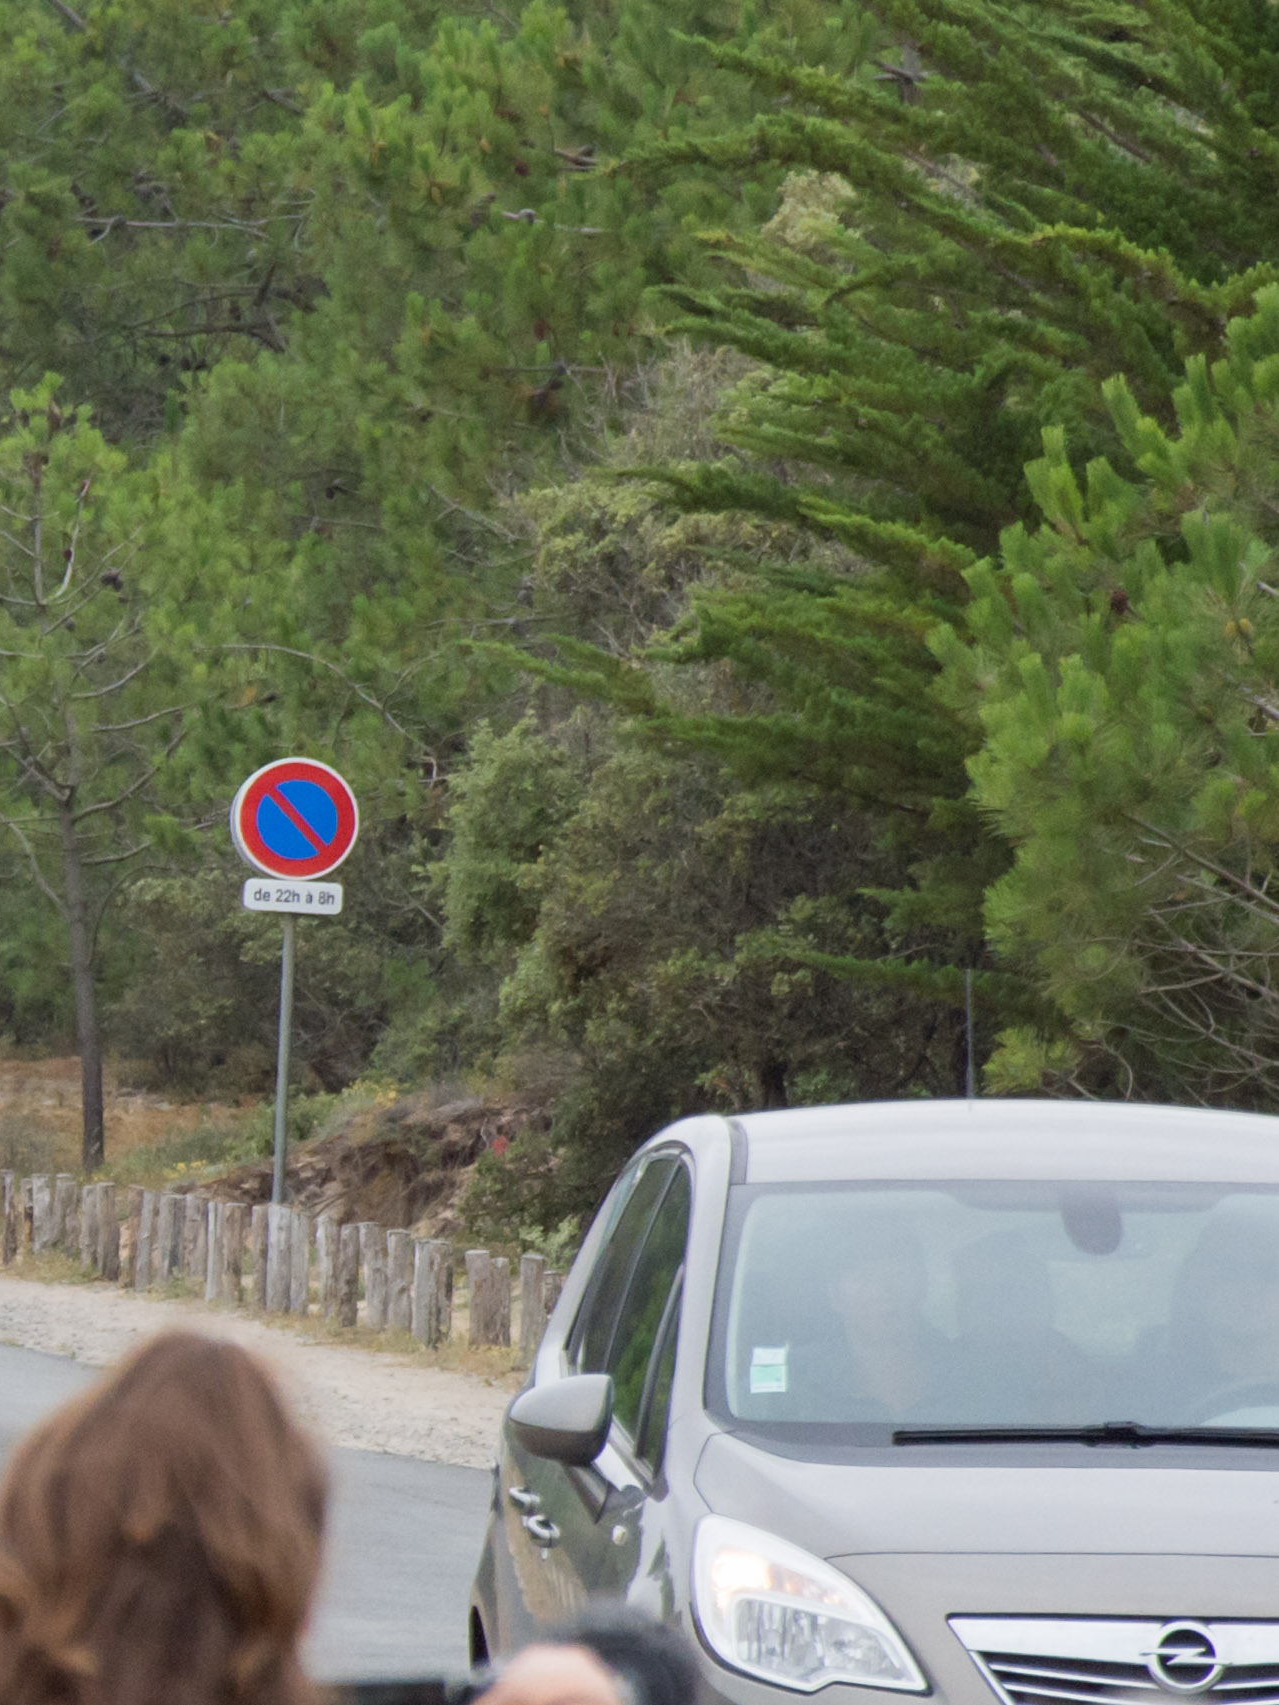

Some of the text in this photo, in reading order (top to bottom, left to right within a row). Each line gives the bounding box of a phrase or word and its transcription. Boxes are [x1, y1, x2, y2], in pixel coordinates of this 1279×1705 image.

[254, 888, 335, 905] de 22h à 8h
